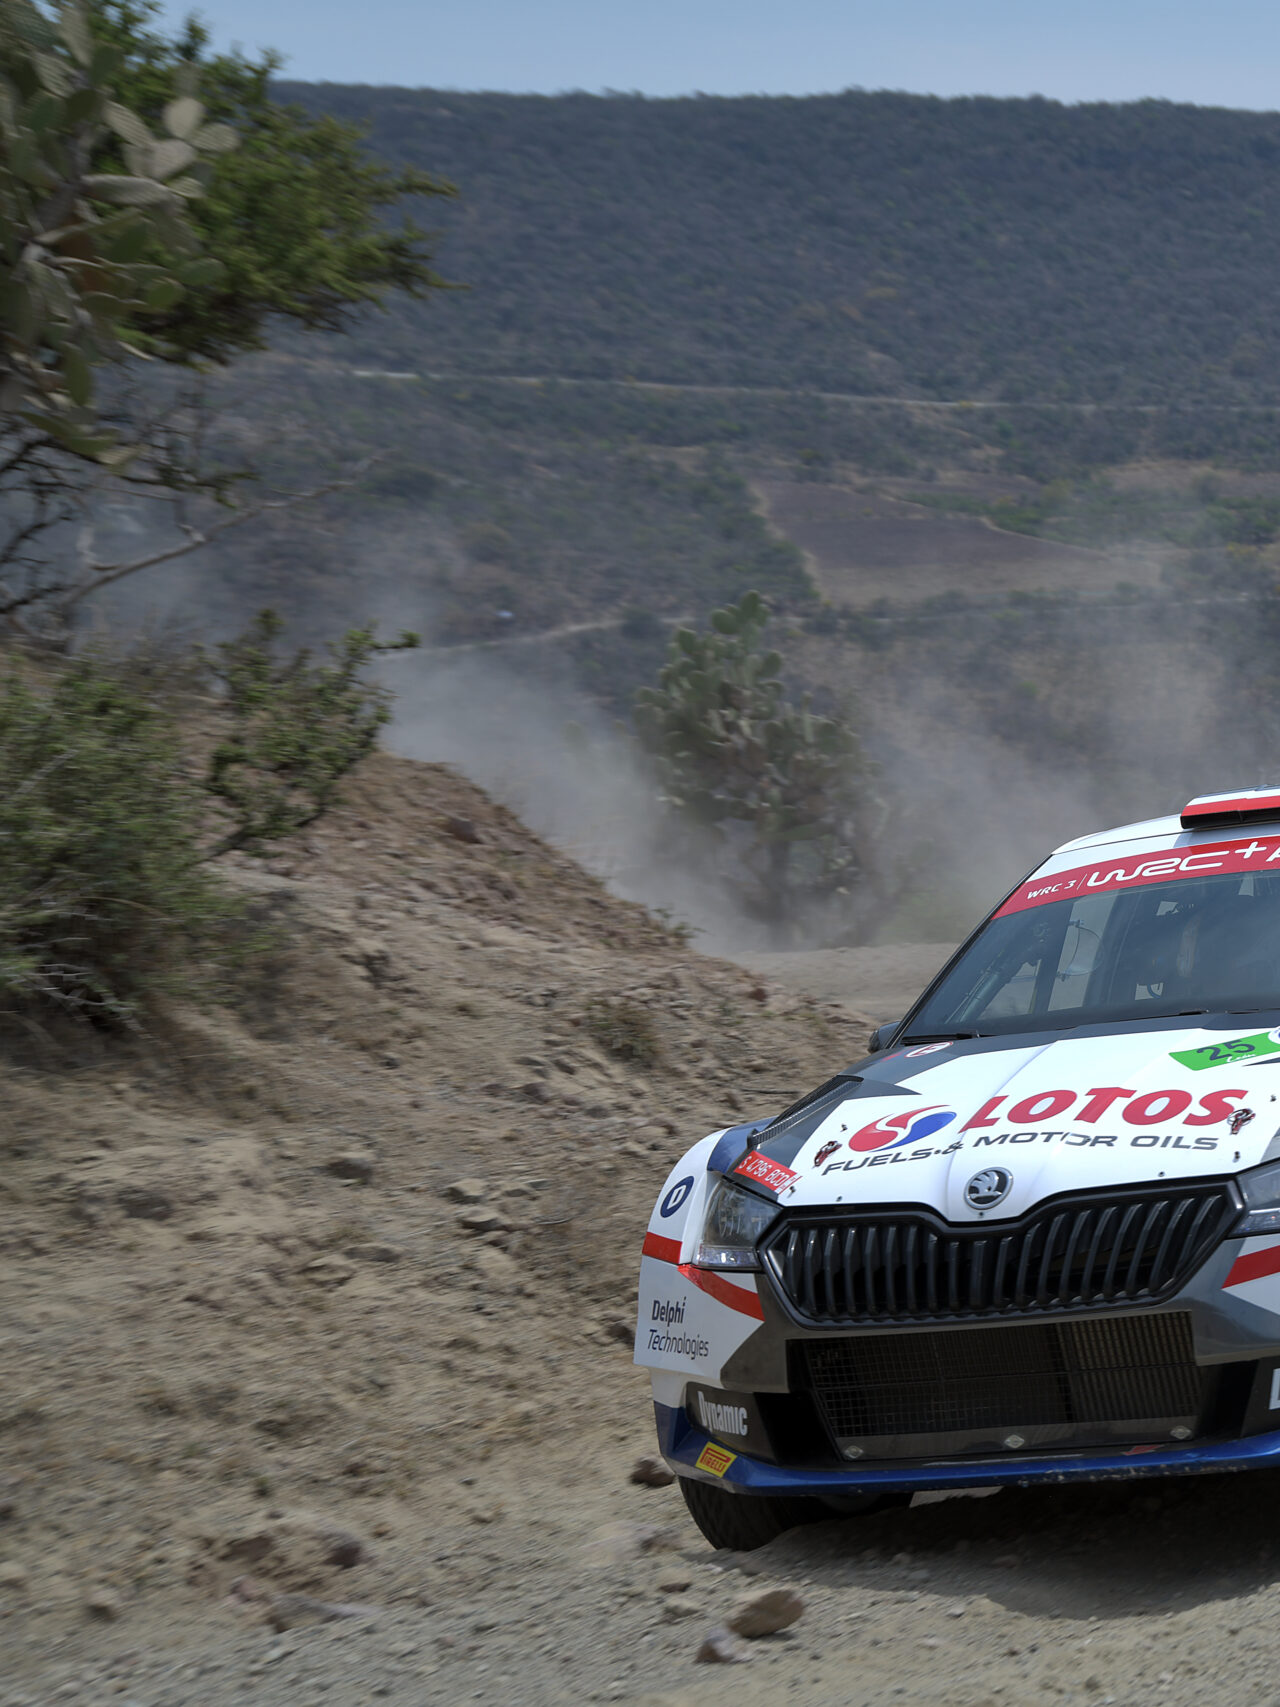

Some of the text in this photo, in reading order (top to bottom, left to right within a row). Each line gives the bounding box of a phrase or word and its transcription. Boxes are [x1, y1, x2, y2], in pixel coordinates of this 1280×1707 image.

[1027, 882, 1062, 900] WRC
[1064, 879, 1077, 890] 3
[1197, 1039, 1255, 1061] 25
[957, 1086, 1250, 1134] LOTOS
[739, 1155, 752, 1167] S
[821, 1147, 933, 1176] FUELS
[972, 1131, 1118, 1148] MOTOR
[1130, 1135, 1220, 1150] OILS
[651, 1296, 686, 1328] Delphi
[647, 1329, 709, 1360] Technologies
[700, 1447, 731, 1473] PIRELLI
